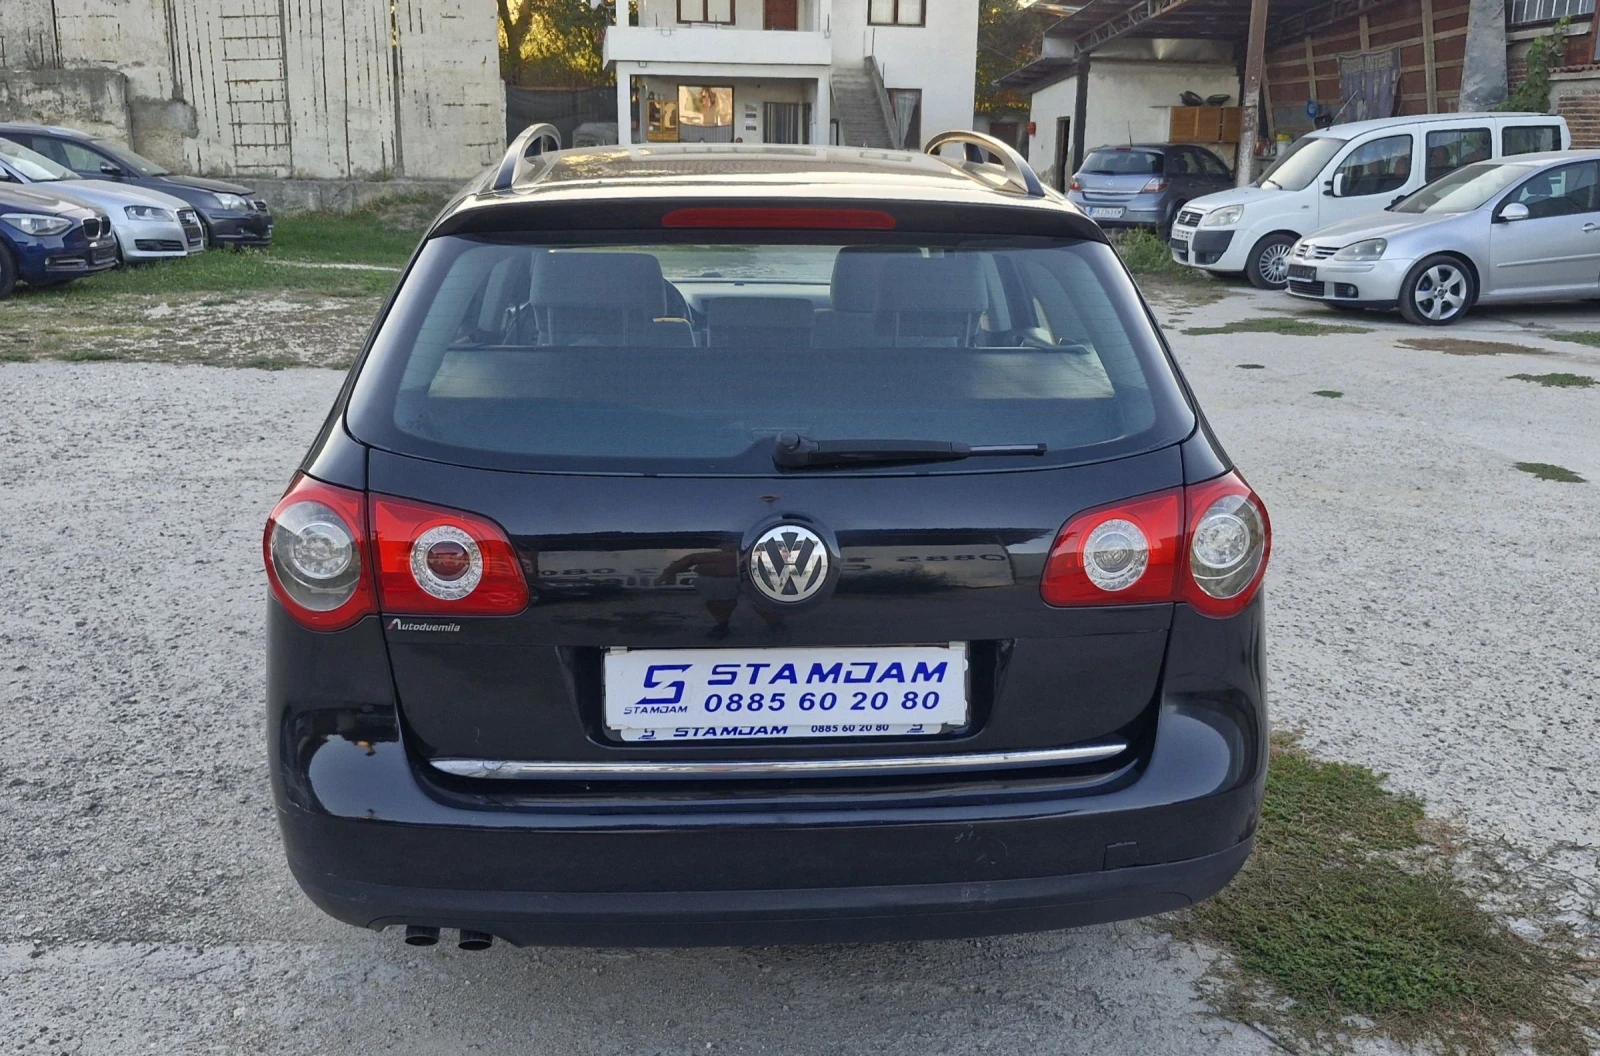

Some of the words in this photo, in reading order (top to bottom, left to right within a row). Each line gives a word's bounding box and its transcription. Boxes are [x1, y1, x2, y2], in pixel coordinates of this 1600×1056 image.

[387, 618, 461, 632] Autoduemila
[707, 662, 949, 686] STAMJAM
[704, 692, 786, 713] 0885
[798, 692, 837, 711] 60
[849, 691, 889, 711] 20
[901, 691, 940, 710] 80
[811, 724, 839, 733] 0885
[842, 724, 856, 732] 60
[859, 724, 873, 732] 20
[875, 724, 890, 732] 80
